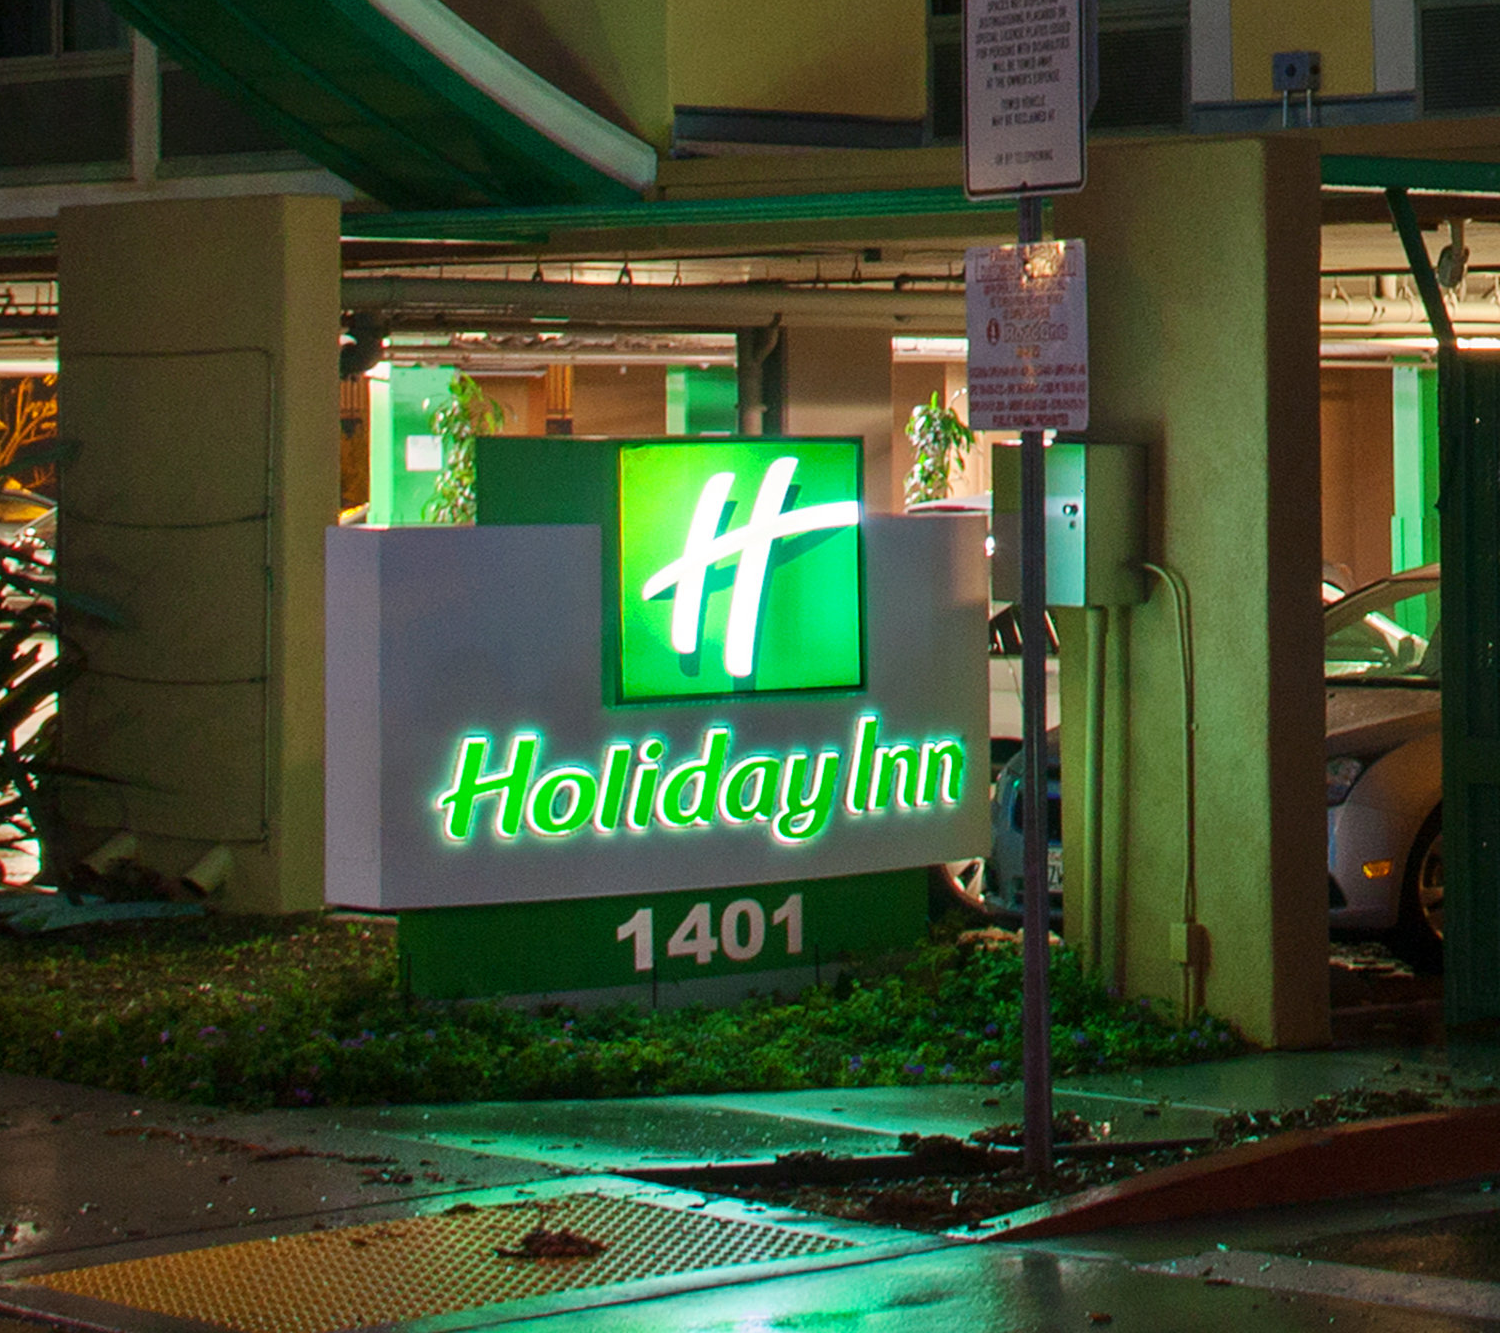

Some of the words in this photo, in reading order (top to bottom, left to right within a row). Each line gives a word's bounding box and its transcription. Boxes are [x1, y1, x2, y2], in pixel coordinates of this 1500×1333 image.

[437, 725, 842, 845] Holiday
[846, 715, 965, 816] Inn
[616, 893, 805, 973] 1401
